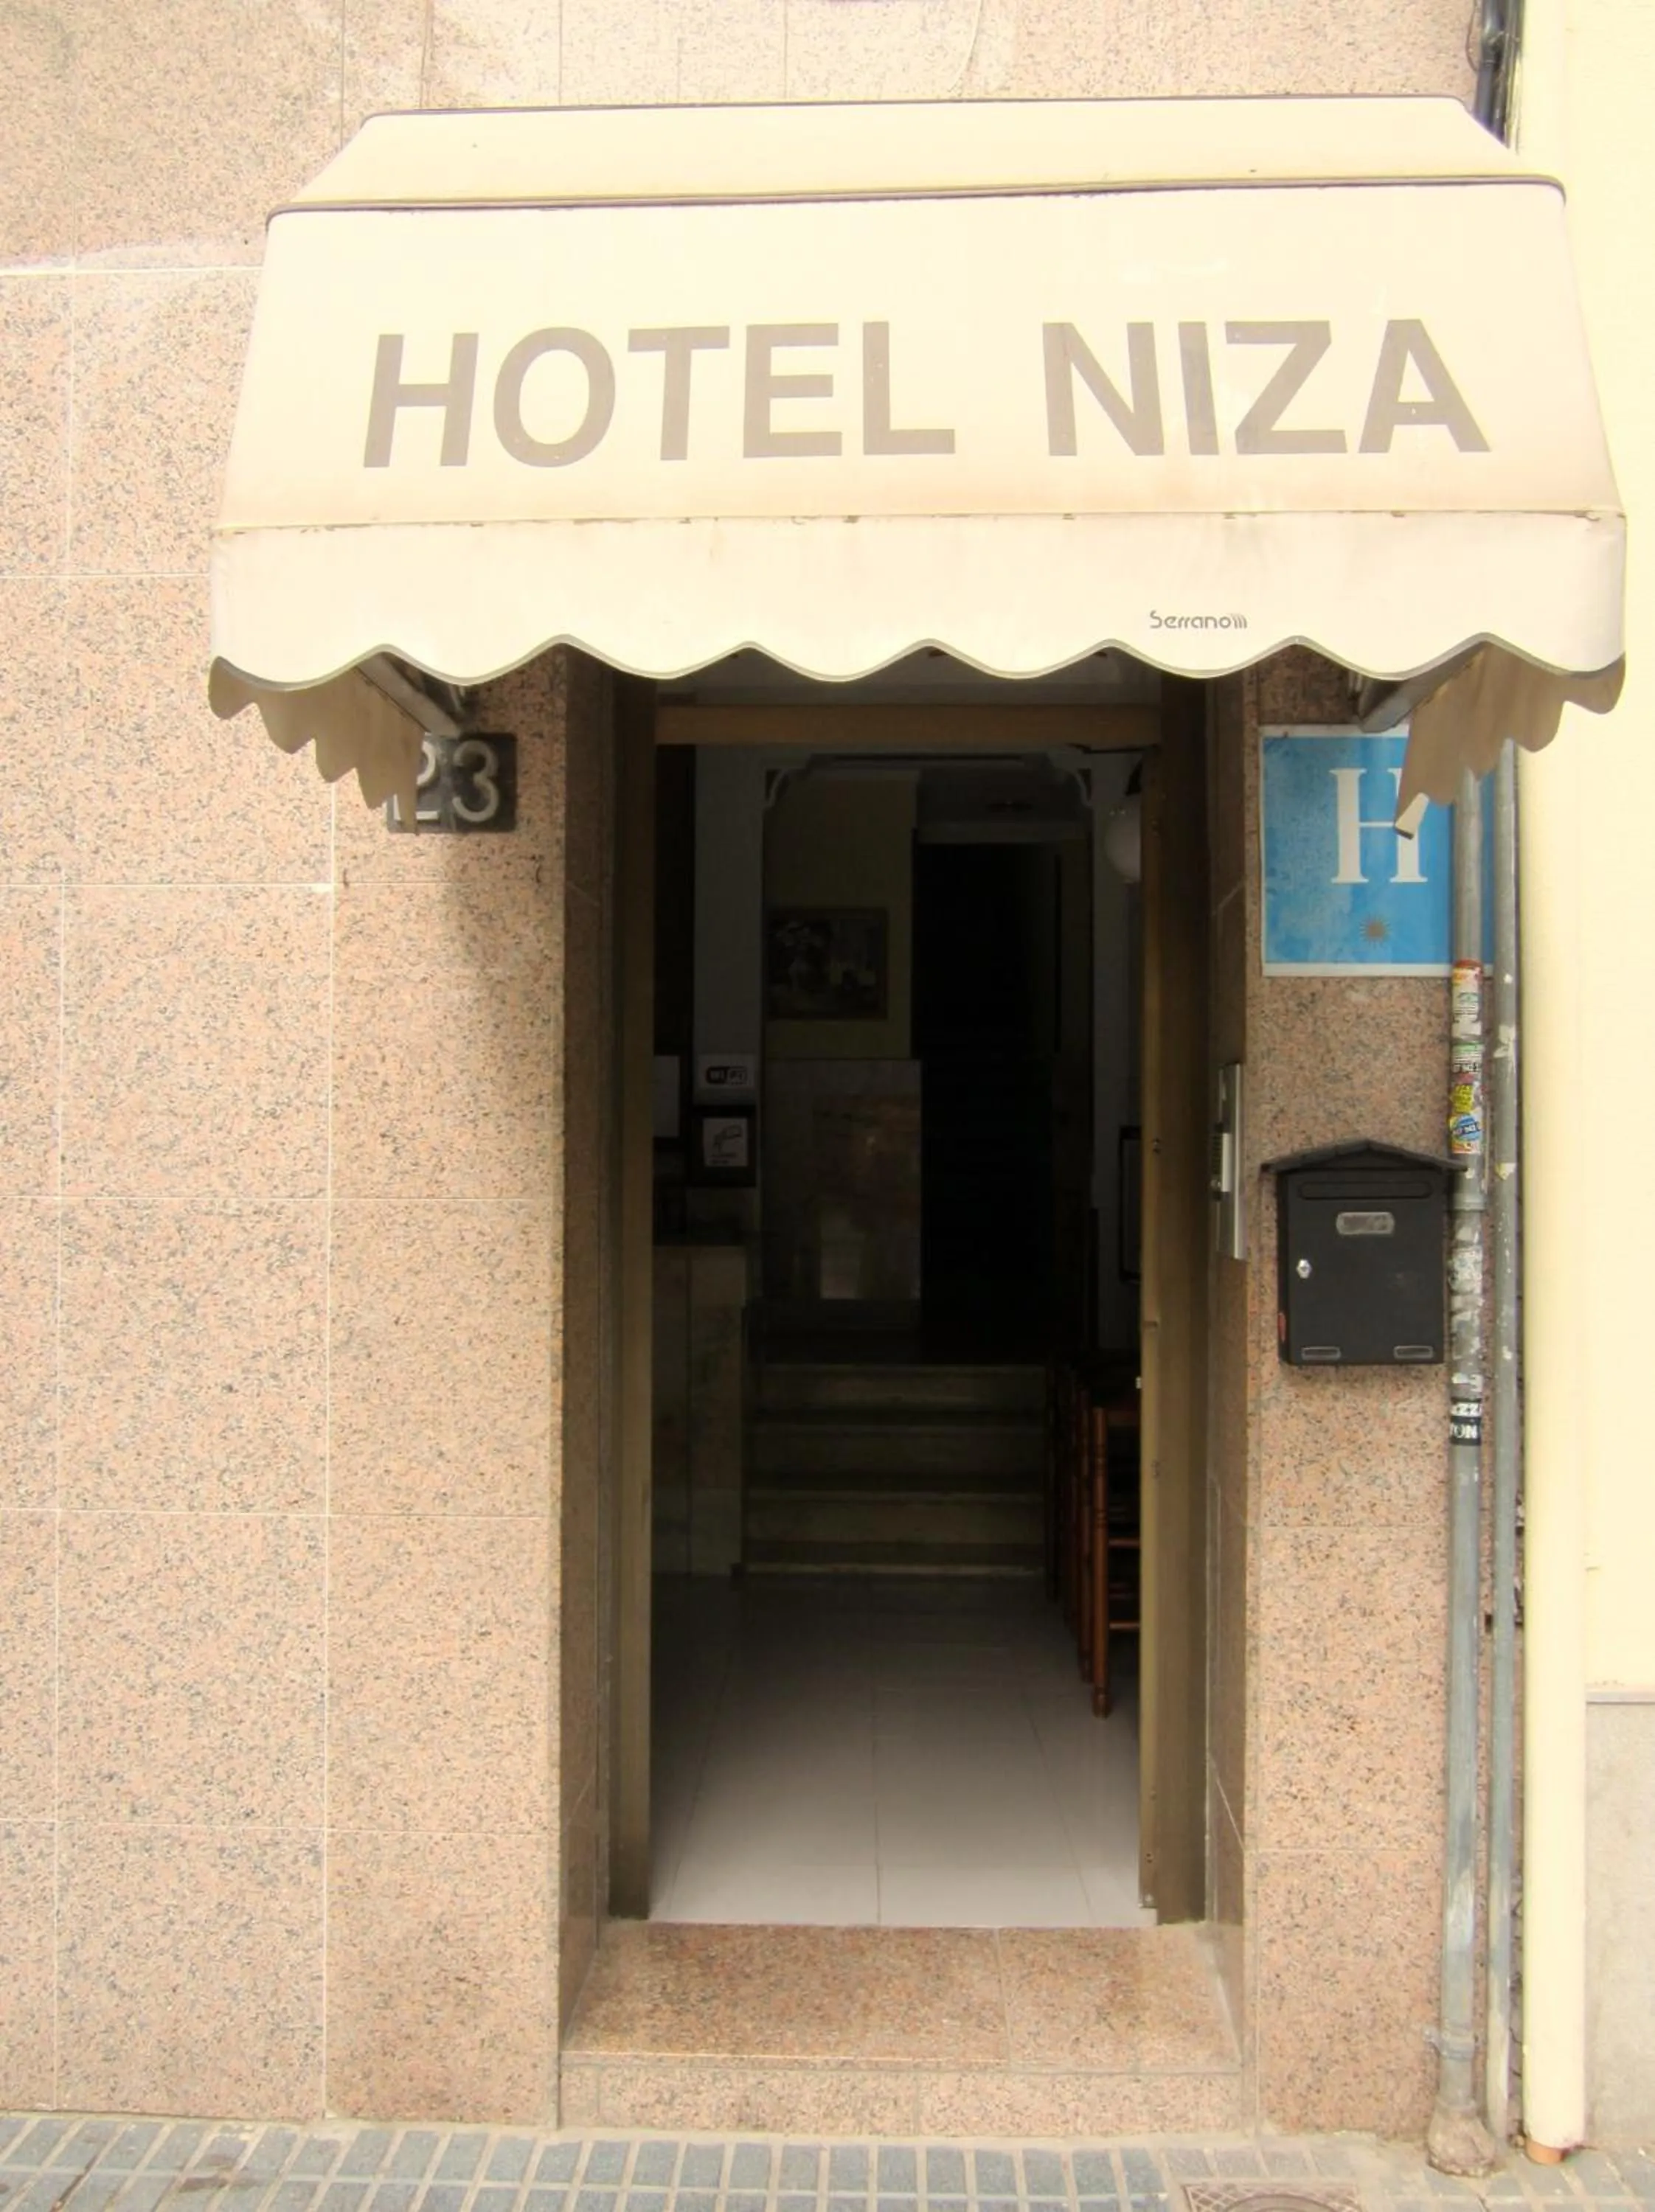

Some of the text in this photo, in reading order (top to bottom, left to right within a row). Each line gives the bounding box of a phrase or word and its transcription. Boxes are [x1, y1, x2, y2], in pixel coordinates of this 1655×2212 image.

[363, 319, 1491, 468] HOTEL NIZA
[1149, 610, 1232, 629] Serrano
[1328, 768, 1429, 884] H
